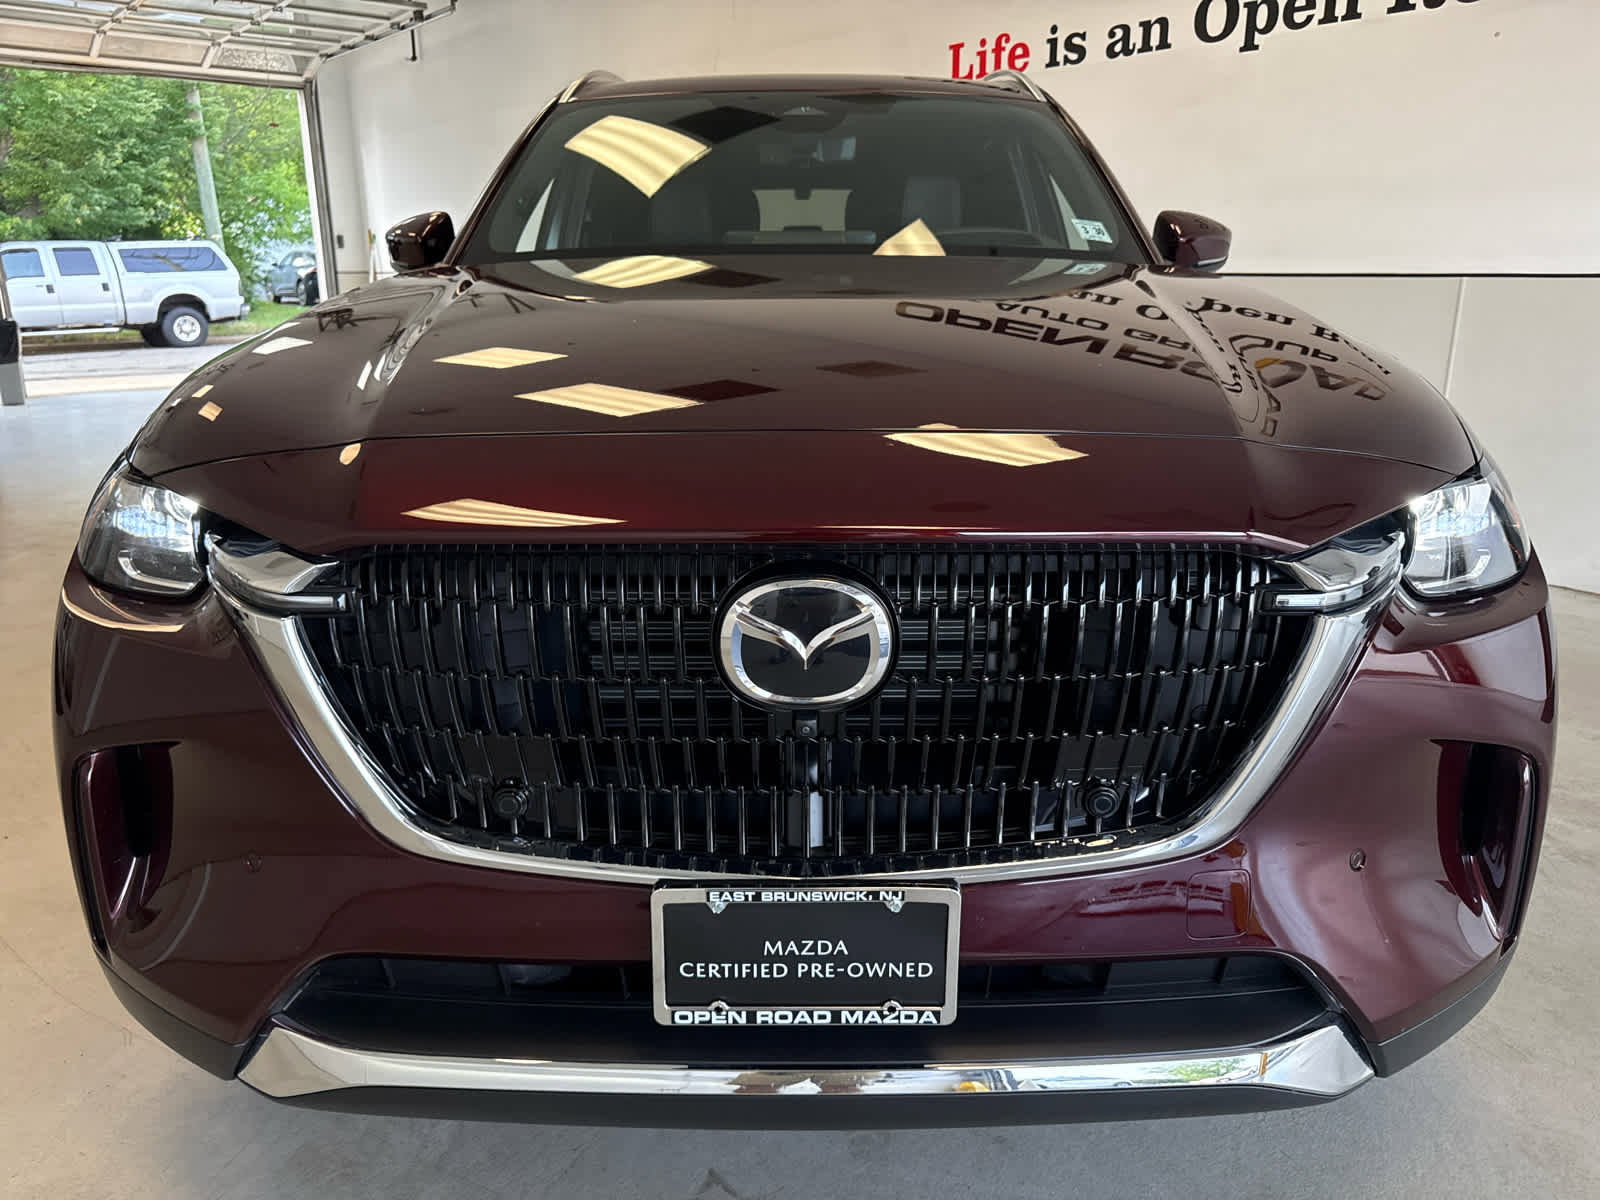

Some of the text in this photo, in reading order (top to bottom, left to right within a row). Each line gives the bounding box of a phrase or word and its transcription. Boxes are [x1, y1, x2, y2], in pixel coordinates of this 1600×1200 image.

[949, 33, 1030, 80] Life
[1045, 24, 1087, 68] is
[1105, 16, 1172, 59] an
[709, 890, 904, 902] EAST BRUNSWICK, NJ
[763, 939, 849, 956] MAZDA
[679, 962, 934, 979] CERTIFIED PRE-OWNED
[673, 1009, 938, 1025] OPEN ROAD MAZDA
